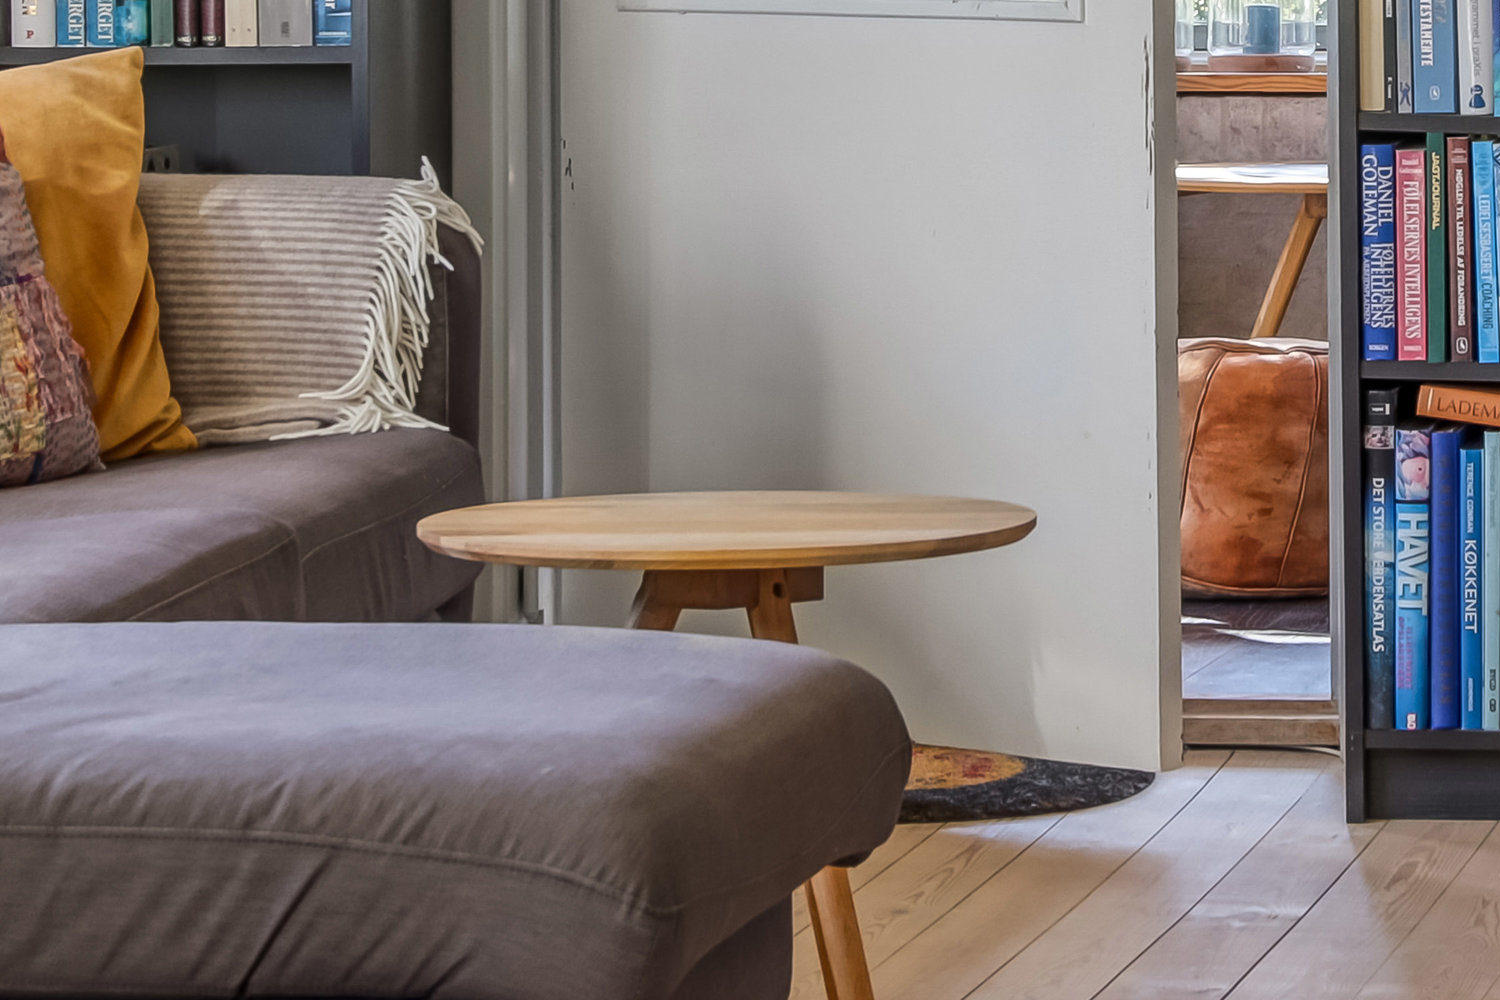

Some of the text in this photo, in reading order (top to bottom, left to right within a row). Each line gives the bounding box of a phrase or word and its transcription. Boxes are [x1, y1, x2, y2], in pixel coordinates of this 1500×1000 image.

[1362, 154, 1378, 236] GOLEMAN
[1377, 166, 1393, 226] DANIEL
[1431, 152, 1440, 230] JAGTJOURNAL
[1370, 243, 1384, 328] INTELLIGENS
[1381, 242, 1394, 328] FØLELSERNES
[1403, 180, 1421, 338] FØLELSERNES INTELLIGENS
[1481, 283, 1493, 329] COACHING
[1372, 477, 1385, 503] DET
[1466, 462, 1474, 498] TERENCE
[1373, 506, 1384, 548] STORE
[1397, 512, 1428, 616] HAVET
[1463, 539, 1477, 634] KØKKENET
